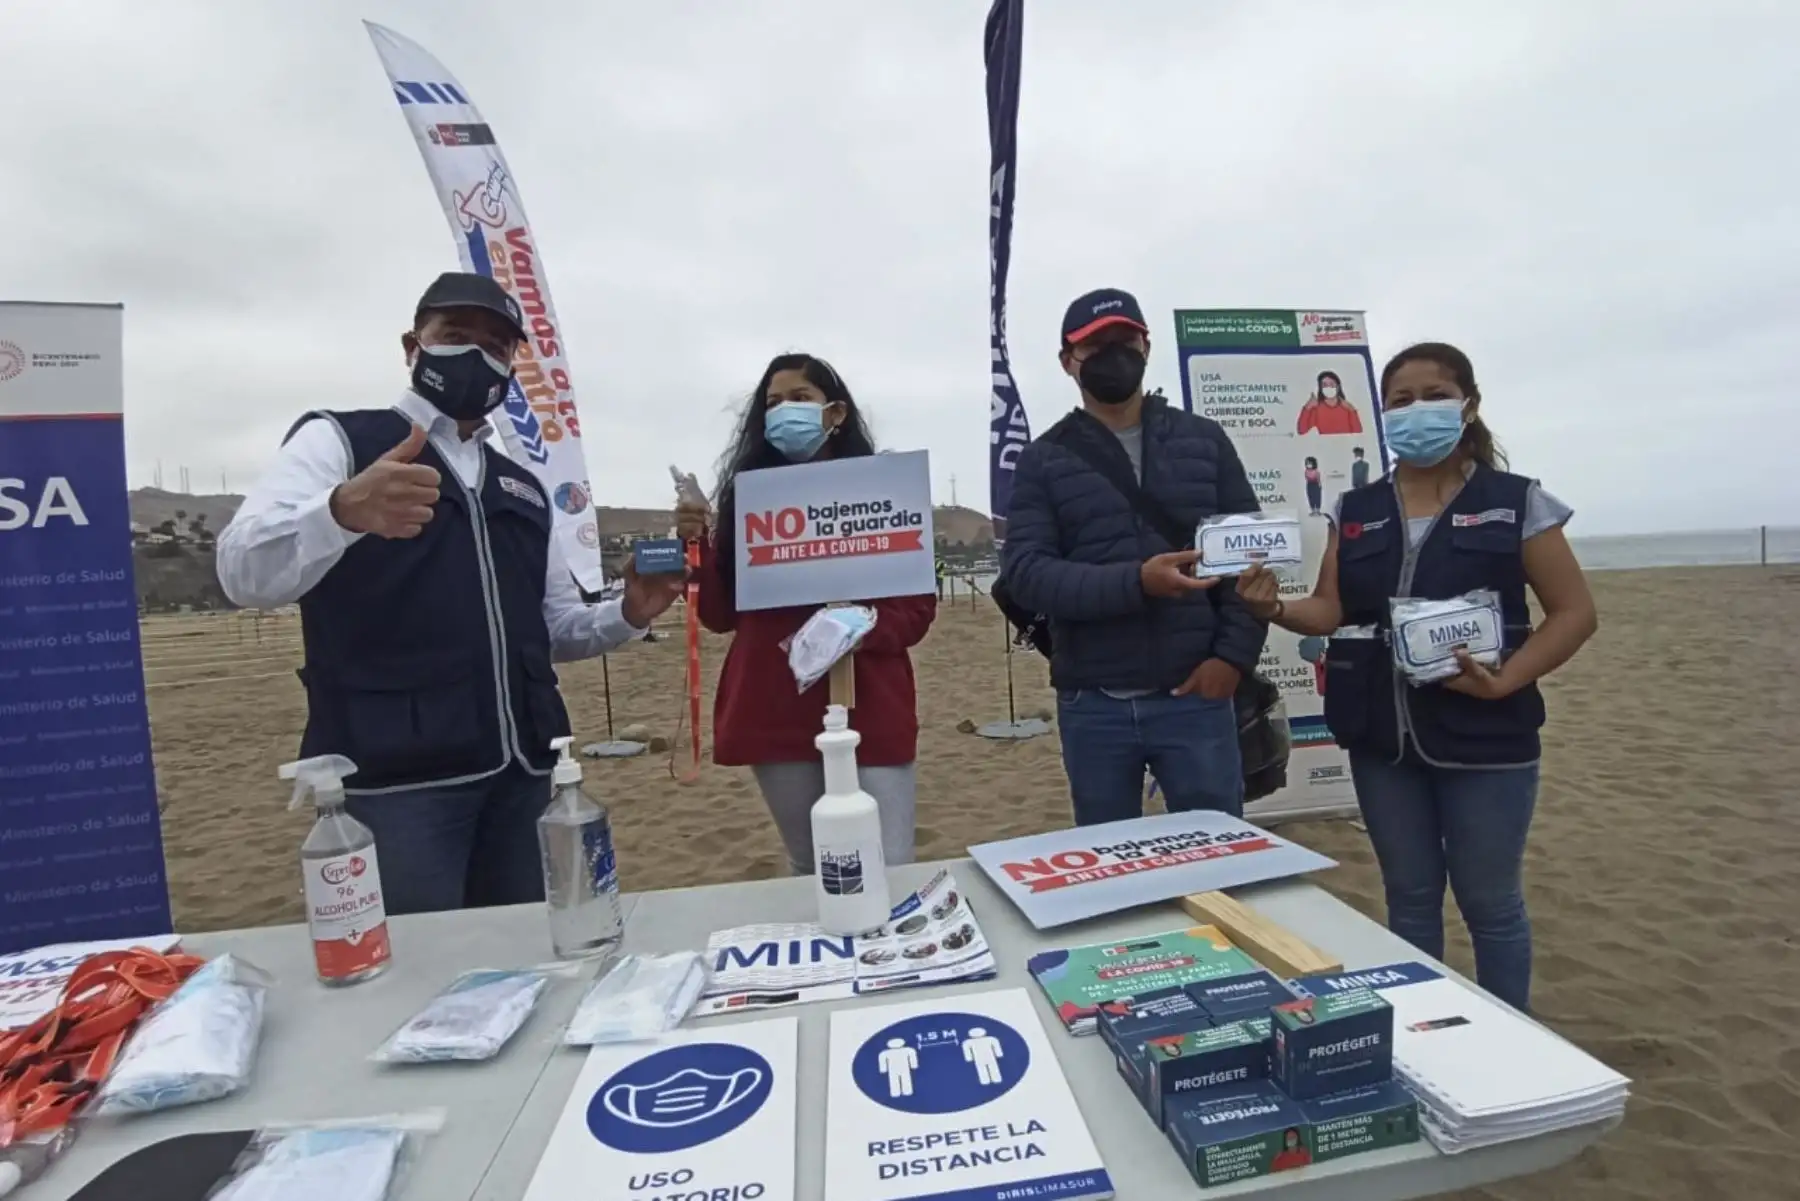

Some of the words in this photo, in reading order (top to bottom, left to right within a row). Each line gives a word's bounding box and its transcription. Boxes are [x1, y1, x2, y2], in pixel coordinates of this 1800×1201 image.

[505, 226, 560, 358] Vamos
[1245, 324, 1292, 334] COVID-19
[1200, 372, 1222, 382] USA
[1202, 384, 1288, 394] CORRECTAMENTE
[1203, 396, 1216, 405] LA
[1205, 407, 1265, 416] CUBRIENDO
[1219, 419, 1238, 428] RIZ
[1239, 419, 1246, 428] Y
[1247, 418, 1277, 428] BOCA
[807, 499, 893, 522] bajemos
[744, 506, 807, 545] NO
[816, 520, 835, 537] la
[840, 509, 923, 537] guardia
[772, 545, 807, 561] ANTE
[809, 543, 827, 557] LA
[829, 535, 891, 556] COVID-19
[1223, 532, 1287, 549] MINSA
[56, 570, 77, 584] de
[81, 567, 126, 583] Salud
[61, 631, 82, 646] de
[86, 628, 132, 644] Salud
[1428, 619, 1482, 645] MINSA
[1281, 668, 1289, 677] Y
[1291, 667, 1308, 677] LAS
[67, 696, 88, 710] de
[92, 690, 138, 706] Salud
[100, 752, 145, 768] Salud
[106, 811, 151, 829] Salud
[1091, 829, 1212, 857] bajemos
[1000, 849, 1102, 882] NO
[1114, 848, 1141, 861] la
[1149, 830, 1260, 857] guardia
[1064, 863, 1122, 886] ANTE
[1122, 859, 1149, 874] LA
[1151, 844, 1234, 869] COVID-19
[115, 872, 159, 889] Salud
[314, 900, 358, 917] ALCOHOL
[715, 935, 856, 973] MIN
[1324, 969, 1410, 991] MINSA
[915, 1031, 939, 1044] 1.5
[942, 1029, 958, 1040] M
[1308, 1033, 1381, 1059] PROTÉGETE
[1174, 1066, 1249, 1092] PROTÉGETE
[1199, 1103, 1281, 1126] PROTÉGETE
[867, 1125, 1001, 1158] RESPETE
[1007, 1119, 1048, 1138] LA
[1330, 1134, 1375, 1151] DISTANCIA
[1337, 1126, 1367, 1140] METRO
[878, 1142, 1047, 1182] DISTANCIA
[628, 1167, 694, 1191] USO
[996, 1177, 1097, 1201] DIRISLIMASUR
